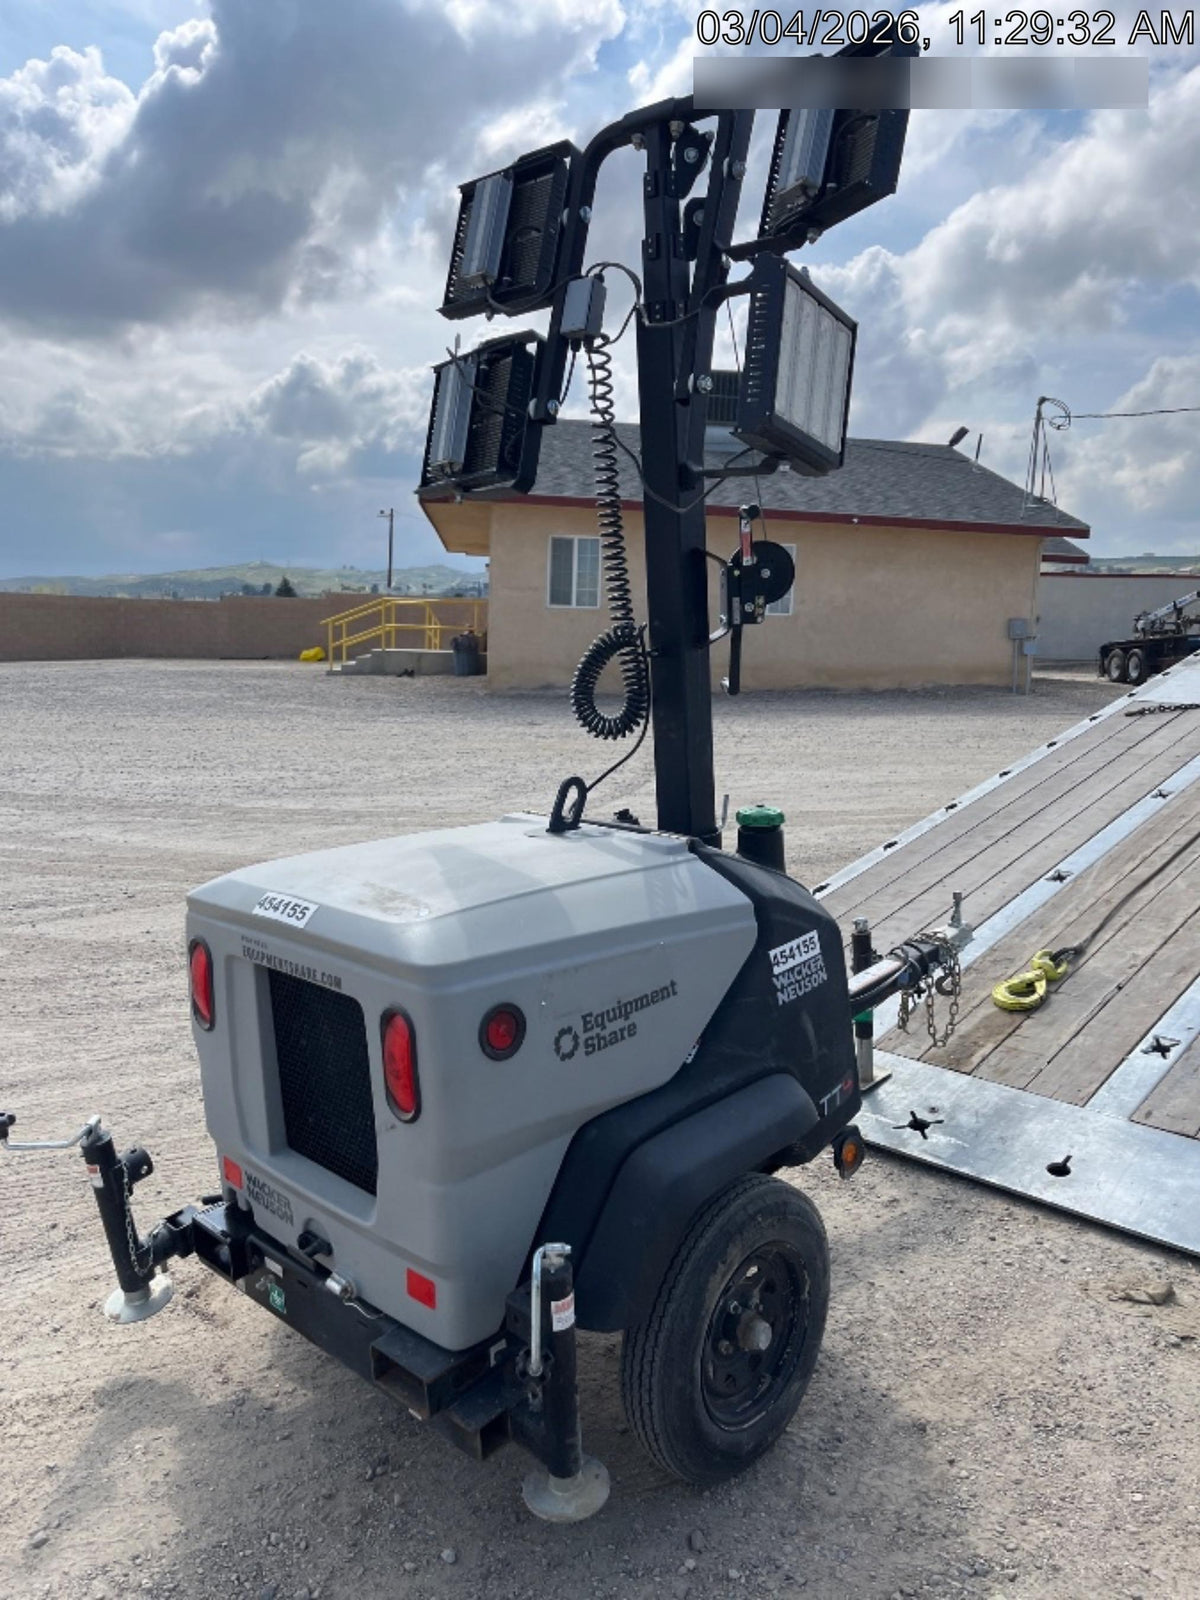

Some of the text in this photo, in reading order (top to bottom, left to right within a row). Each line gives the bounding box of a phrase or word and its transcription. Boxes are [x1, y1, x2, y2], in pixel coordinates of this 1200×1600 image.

[257, 894, 310, 922] 454155
[772, 935, 817, 968] 454155
[776, 968, 828, 1006] NEUSON
[581, 979, 678, 1033] Equipment
[583, 1021, 637, 1056] Share
